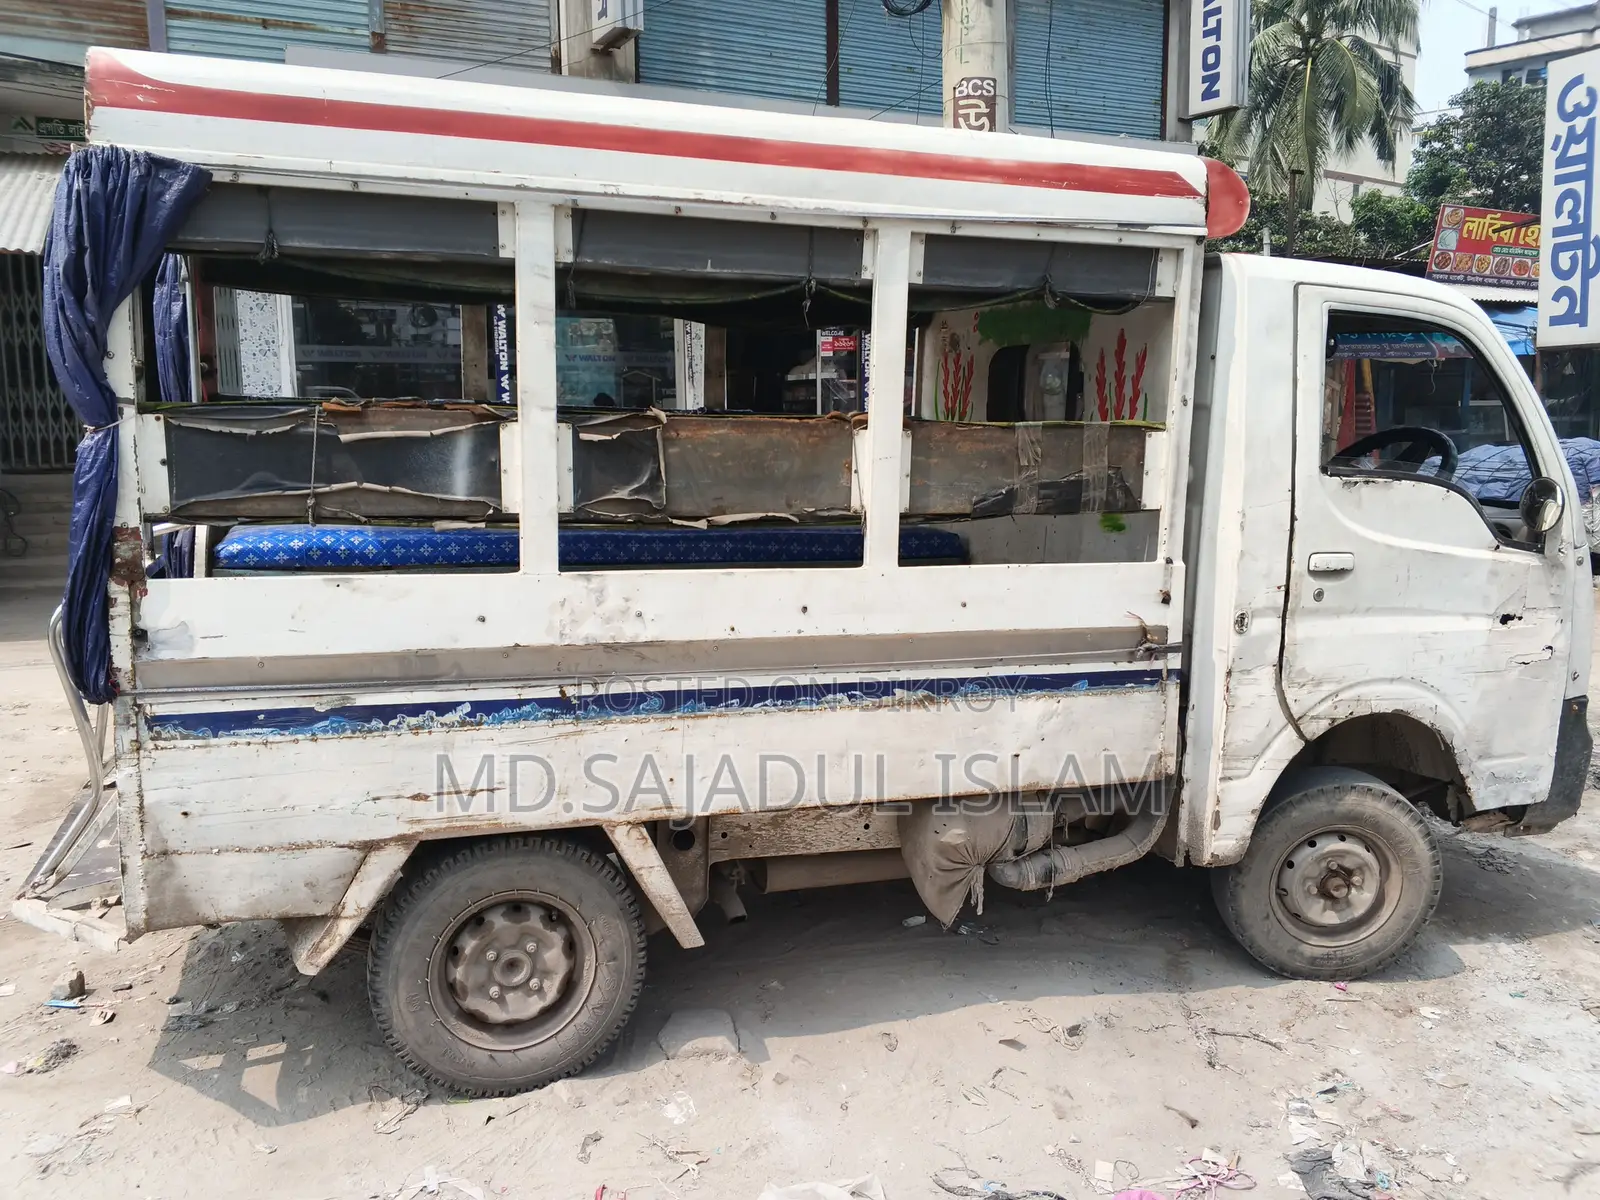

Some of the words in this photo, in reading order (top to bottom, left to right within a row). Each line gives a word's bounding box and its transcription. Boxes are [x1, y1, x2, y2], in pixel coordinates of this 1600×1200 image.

[955, 79, 995, 97] BCS
[1549, 74, 1600, 328] ওয়ালটন
[498, 320, 509, 371] WALTON
